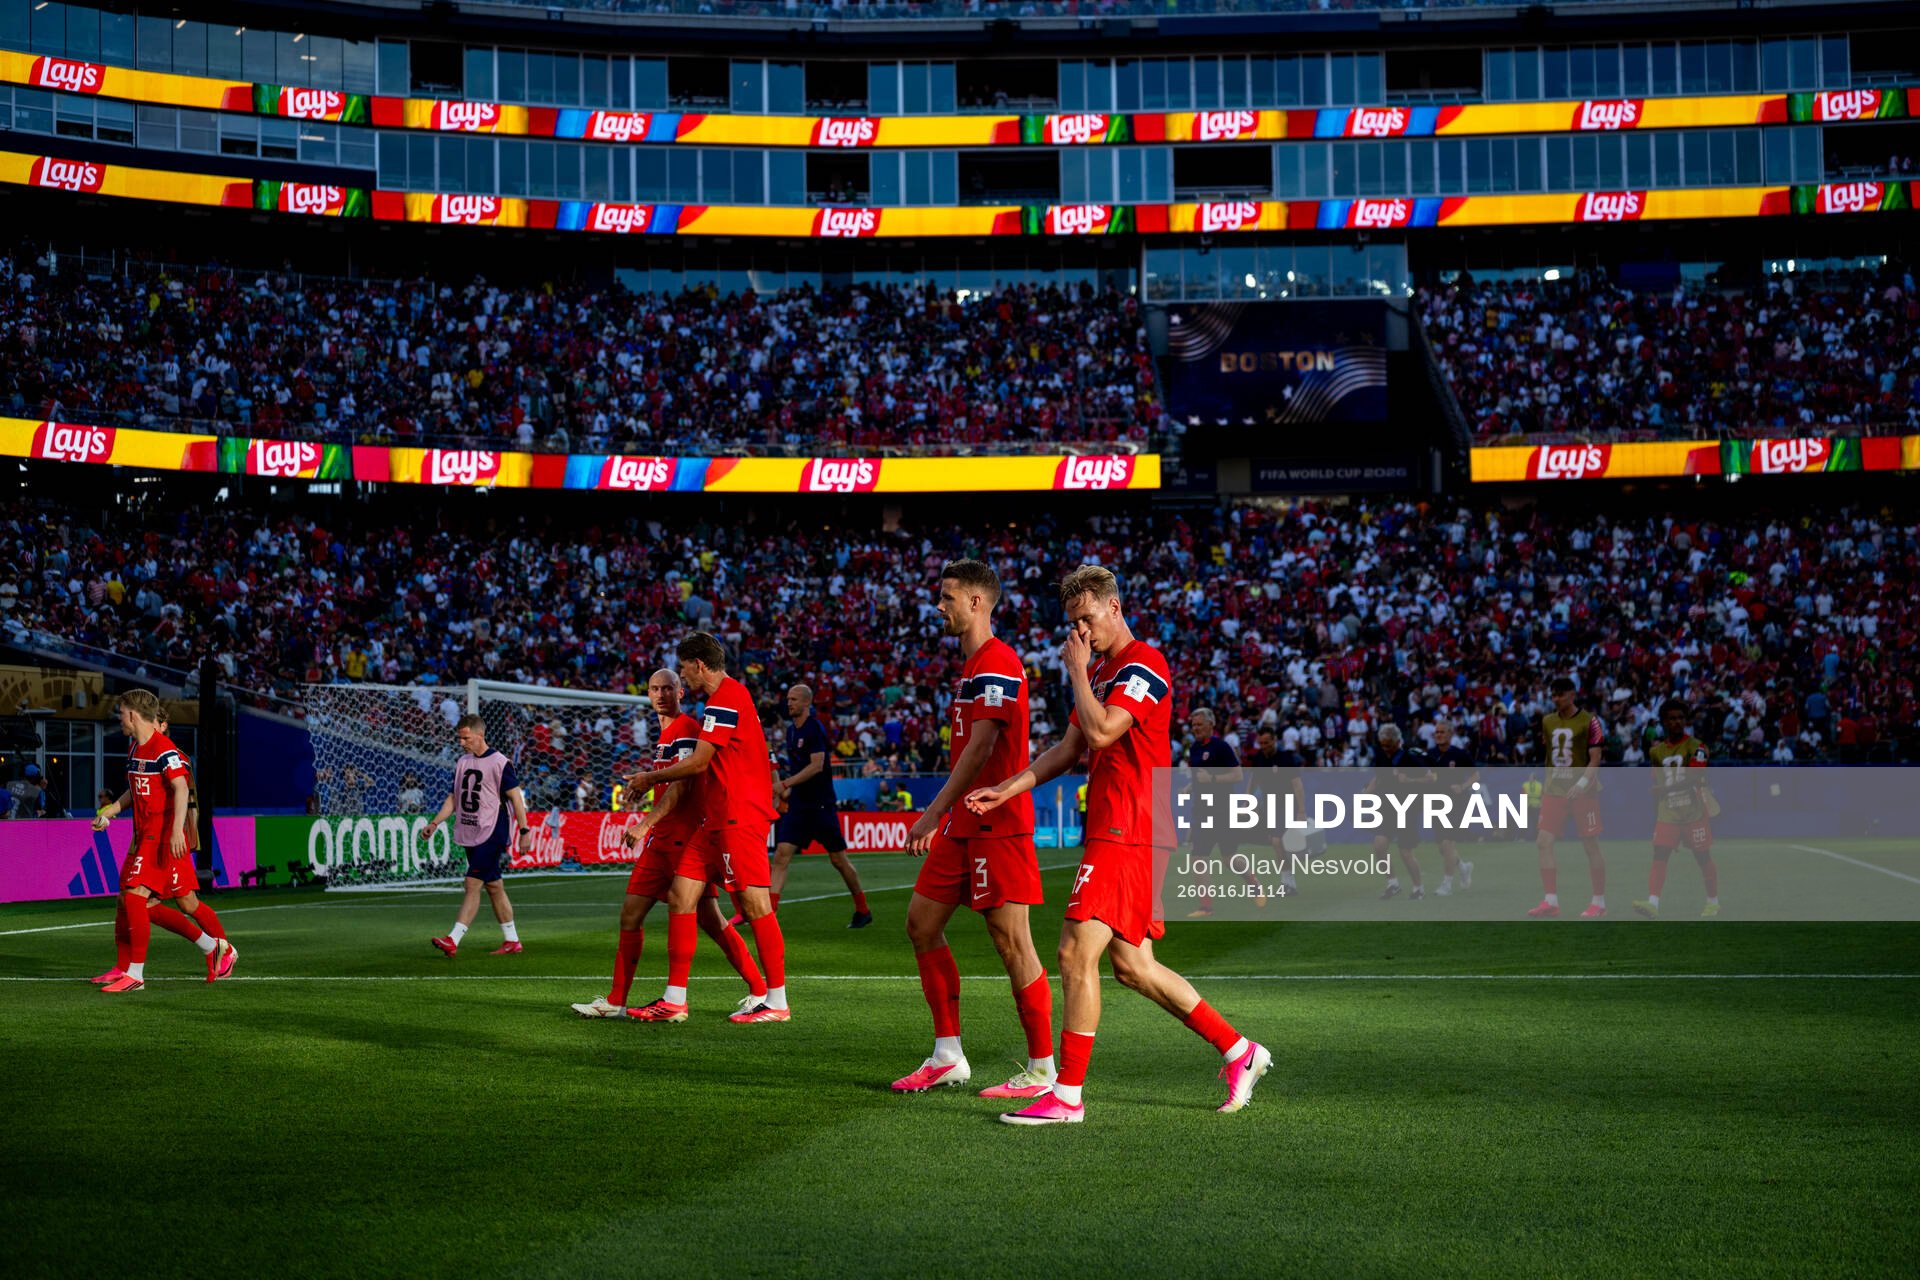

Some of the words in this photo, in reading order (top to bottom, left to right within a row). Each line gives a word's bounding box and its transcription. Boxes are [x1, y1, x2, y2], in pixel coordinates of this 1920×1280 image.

[40, 57, 96, 91] Lay's
[287, 86, 340, 120] Lay's
[440, 101, 495, 130] Lay's
[1581, 100, 1636, 129] Lay's
[1821, 90, 1875, 120] Lay's
[592, 112, 645, 142] Lay's
[819, 118, 874, 147] Lay's
[1051, 114, 1103, 143] Lay's
[1200, 111, 1254, 141] Lay's
[1351, 107, 1404, 137] Lay's
[40, 157, 96, 191] Lay's
[287, 183, 339, 215] Lay's
[441, 194, 495, 224] Lay's
[1354, 198, 1406, 227] Lay's
[1584, 191, 1638, 220] Lay's
[1824, 183, 1877, 213] Lay's
[593, 203, 645, 232] Lay's
[821, 208, 874, 237] Lay's
[1053, 205, 1106, 235] Lay's
[1203, 202, 1255, 231] Lay's
[1220, 351, 1335, 373] BOSTON
[43, 421, 105, 462] Lay's
[1760, 440, 1822, 473] Lay's
[256, 440, 315, 476] Lay's
[432, 450, 494, 486] Lay's
[608, 455, 669, 491] Lay's
[1063, 456, 1127, 490] Lay's
[1537, 443, 1602, 478] Lay's
[810, 458, 873, 492] Lay's
[1259, 470, 1287, 480] FIFA
[1289, 469, 1335, 480] WORLD
[1336, 468, 1362, 479] CUP
[1363, 467, 1407, 478] 2026
[954, 706, 964, 737] 3
[135, 777, 150, 796] 23
[308, 817, 450, 876] aramco
[844, 815, 908, 849] Lenovo
[722, 852, 734, 876] 8
[975, 858, 988, 888] 3
[1072, 864, 1095, 895] 17
